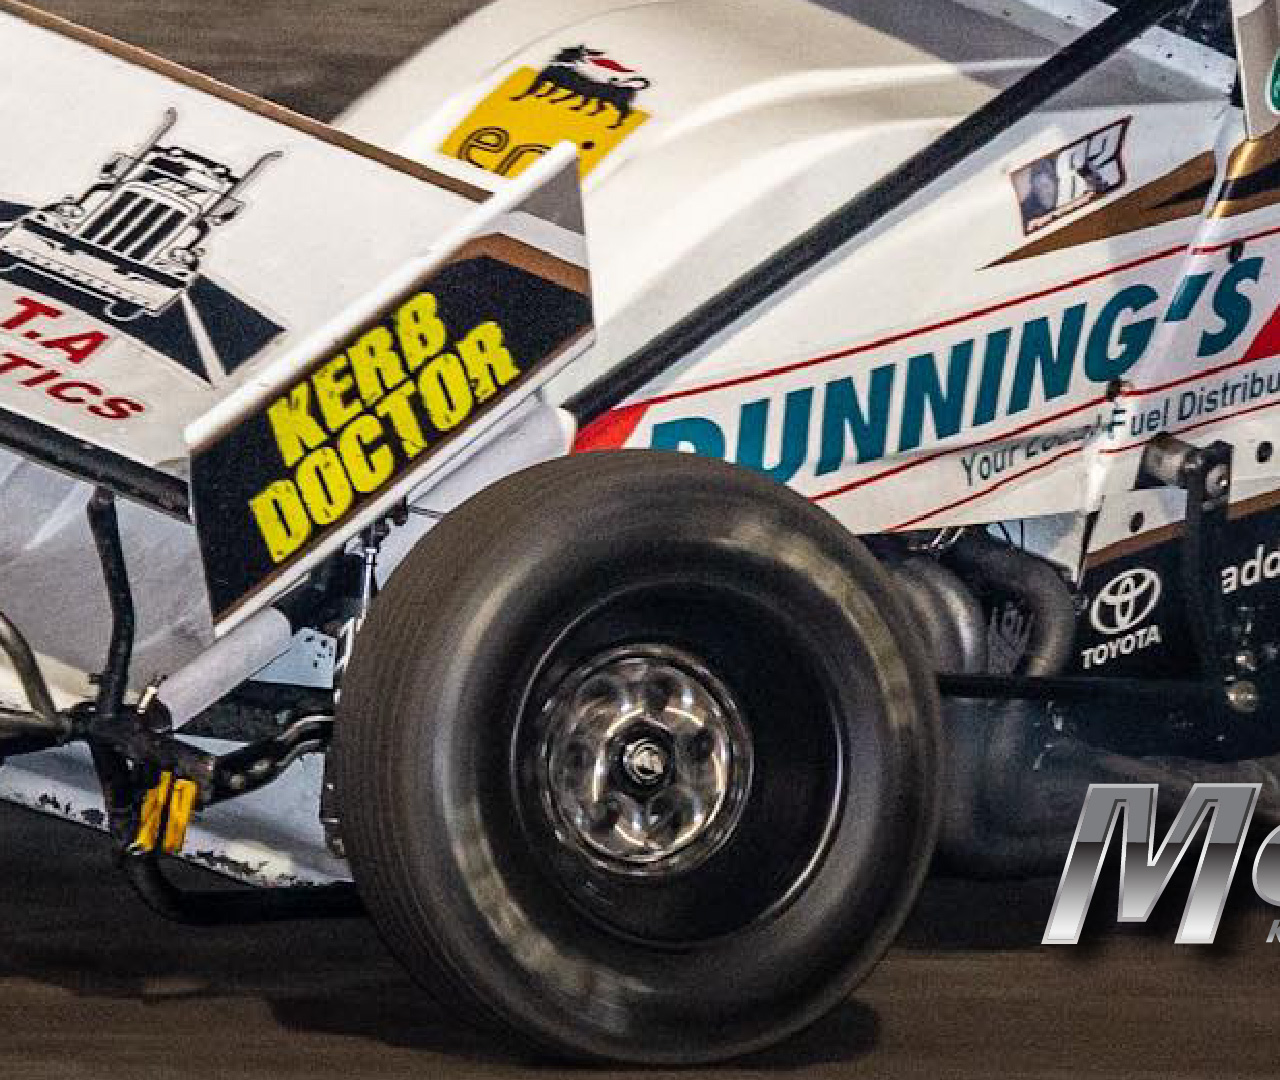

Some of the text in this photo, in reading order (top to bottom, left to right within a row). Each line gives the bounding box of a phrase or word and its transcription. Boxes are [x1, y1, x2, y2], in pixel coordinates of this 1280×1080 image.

[246, 321, 523, 567] DOCTOR
[266, 290, 449, 470] KERB
[960, 444, 1020, 487] Your
[1106, 398, 1171, 440] Fuel
[1081, 626, 1162, 670] TOYOTA
